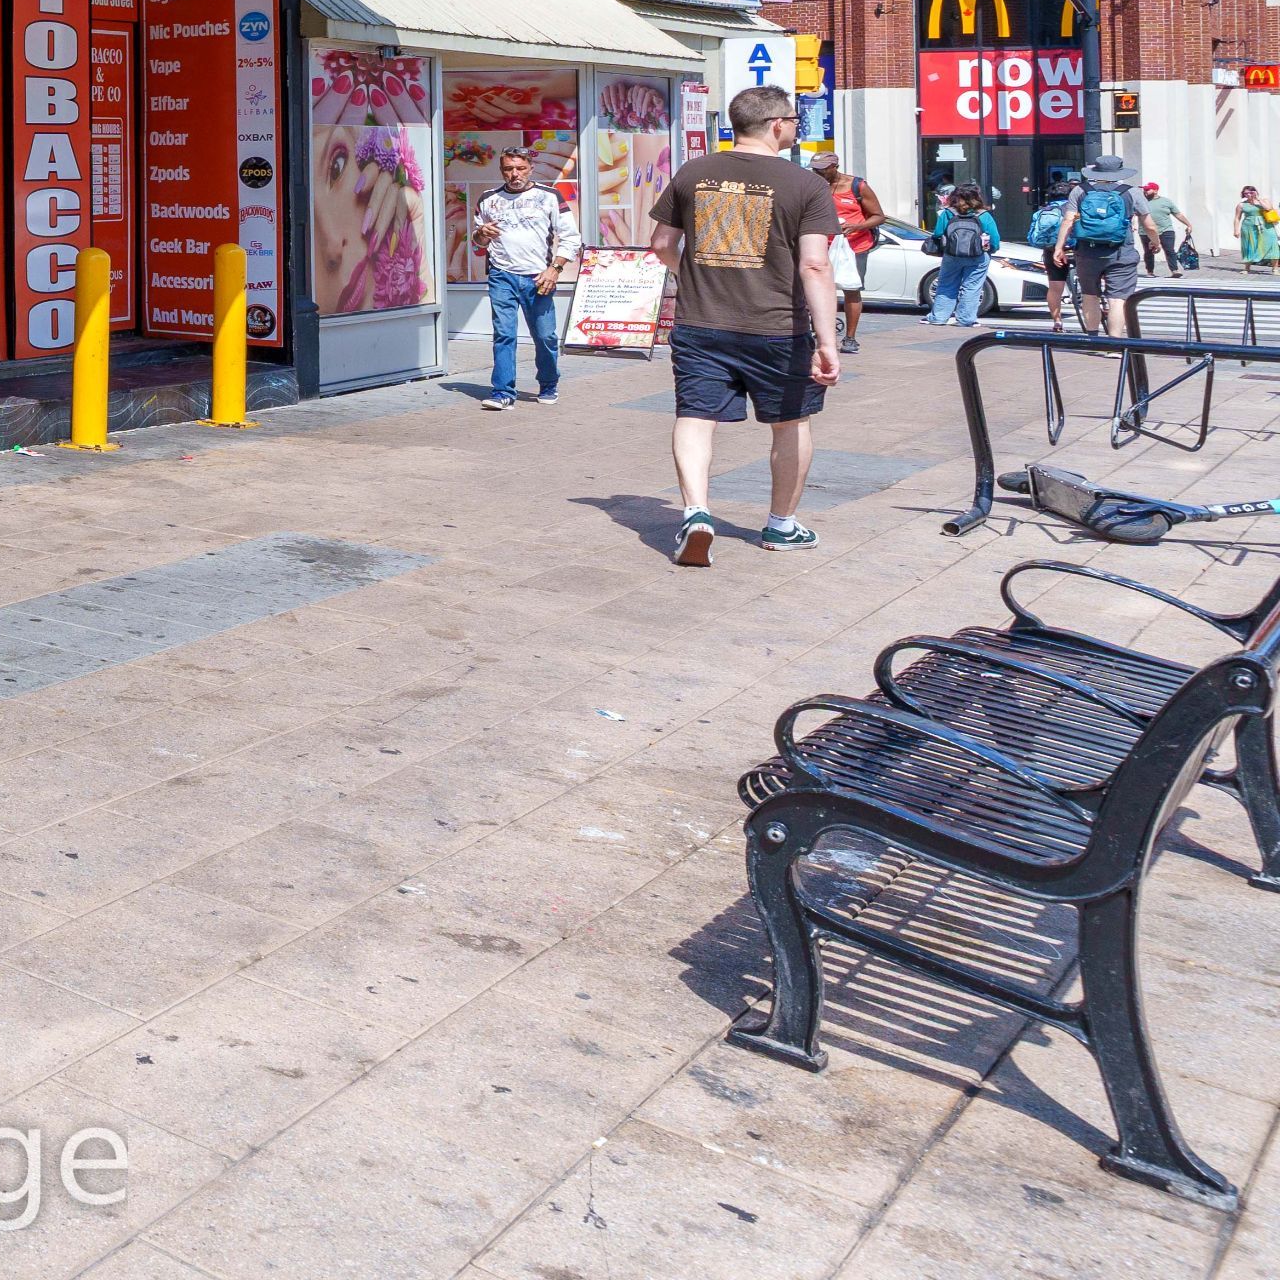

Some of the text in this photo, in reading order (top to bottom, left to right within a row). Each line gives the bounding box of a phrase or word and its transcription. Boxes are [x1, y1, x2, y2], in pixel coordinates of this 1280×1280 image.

[149, 22, 231, 40] Nic Pouches
[241, 20, 269, 32] ZYN
[91, 48, 123, 65] BACCO
[237, 57, 273, 68] 2%-5%
[96, 67, 104, 83] &
[149, 59, 181, 76] Vape
[957, 57, 1083, 88] now
[91, 86, 121, 102] PE CO
[150, 96, 190, 111] Elfbar
[150, 131, 189, 146] Oxbar
[238, 133, 273, 142] OXBAR
[150, 166, 191, 183] Zpods
[242, 169, 273, 177] ZPODS
[150, 202, 230, 220] Backwoods
[150, 238, 211, 255] Geek Bar
[151, 272, 214, 290] Accessori
[248, 281, 273, 290] RAW
[152, 308, 214, 326] And More
